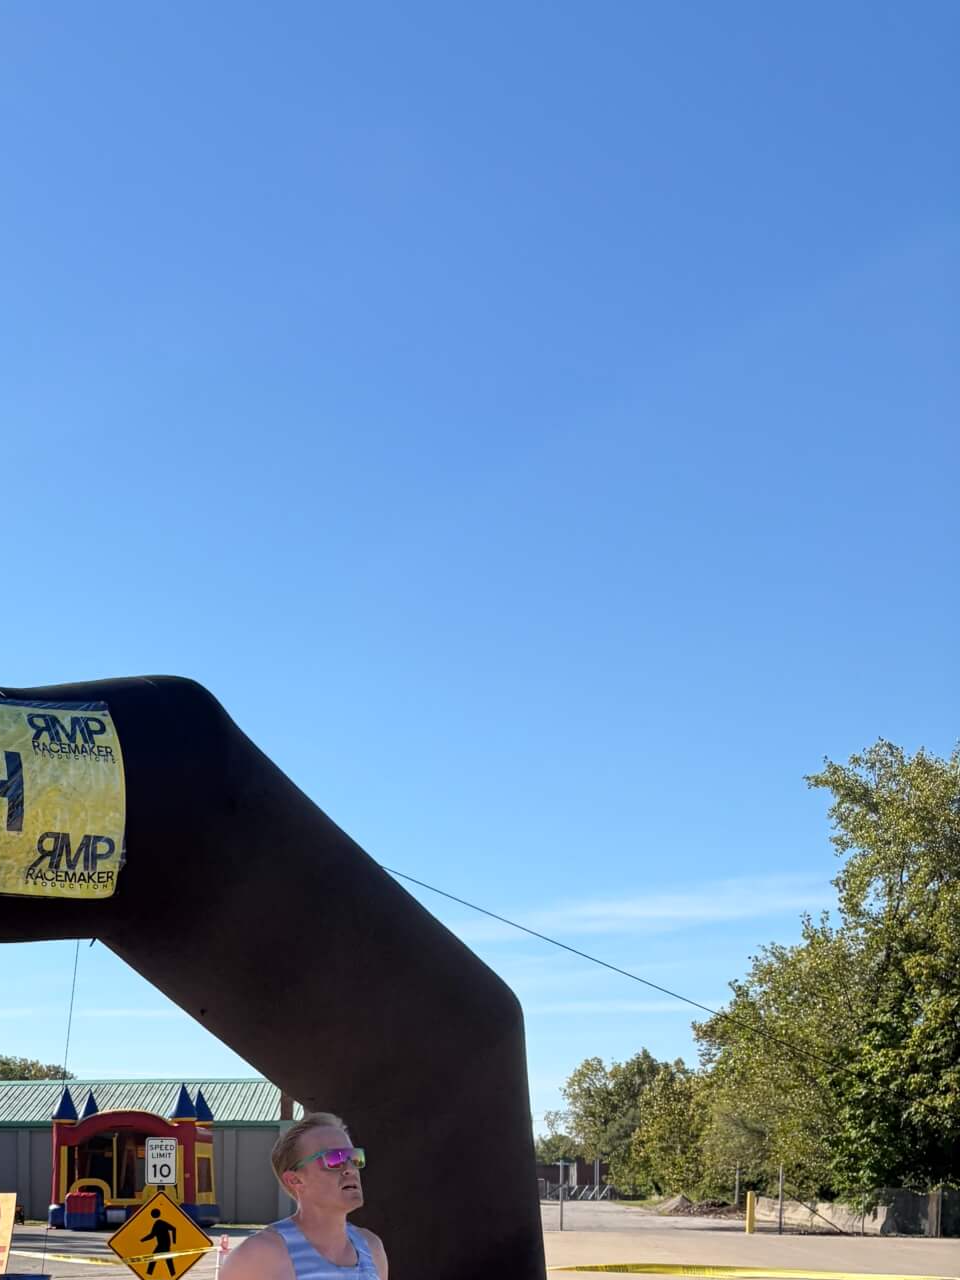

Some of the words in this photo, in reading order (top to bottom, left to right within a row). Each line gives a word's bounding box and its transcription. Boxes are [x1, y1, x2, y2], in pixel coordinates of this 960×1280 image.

[32, 740, 113, 758] RACEMAKER
[25, 867, 114, 884] RACEMAKER
[152, 1163, 171, 1178] 10
